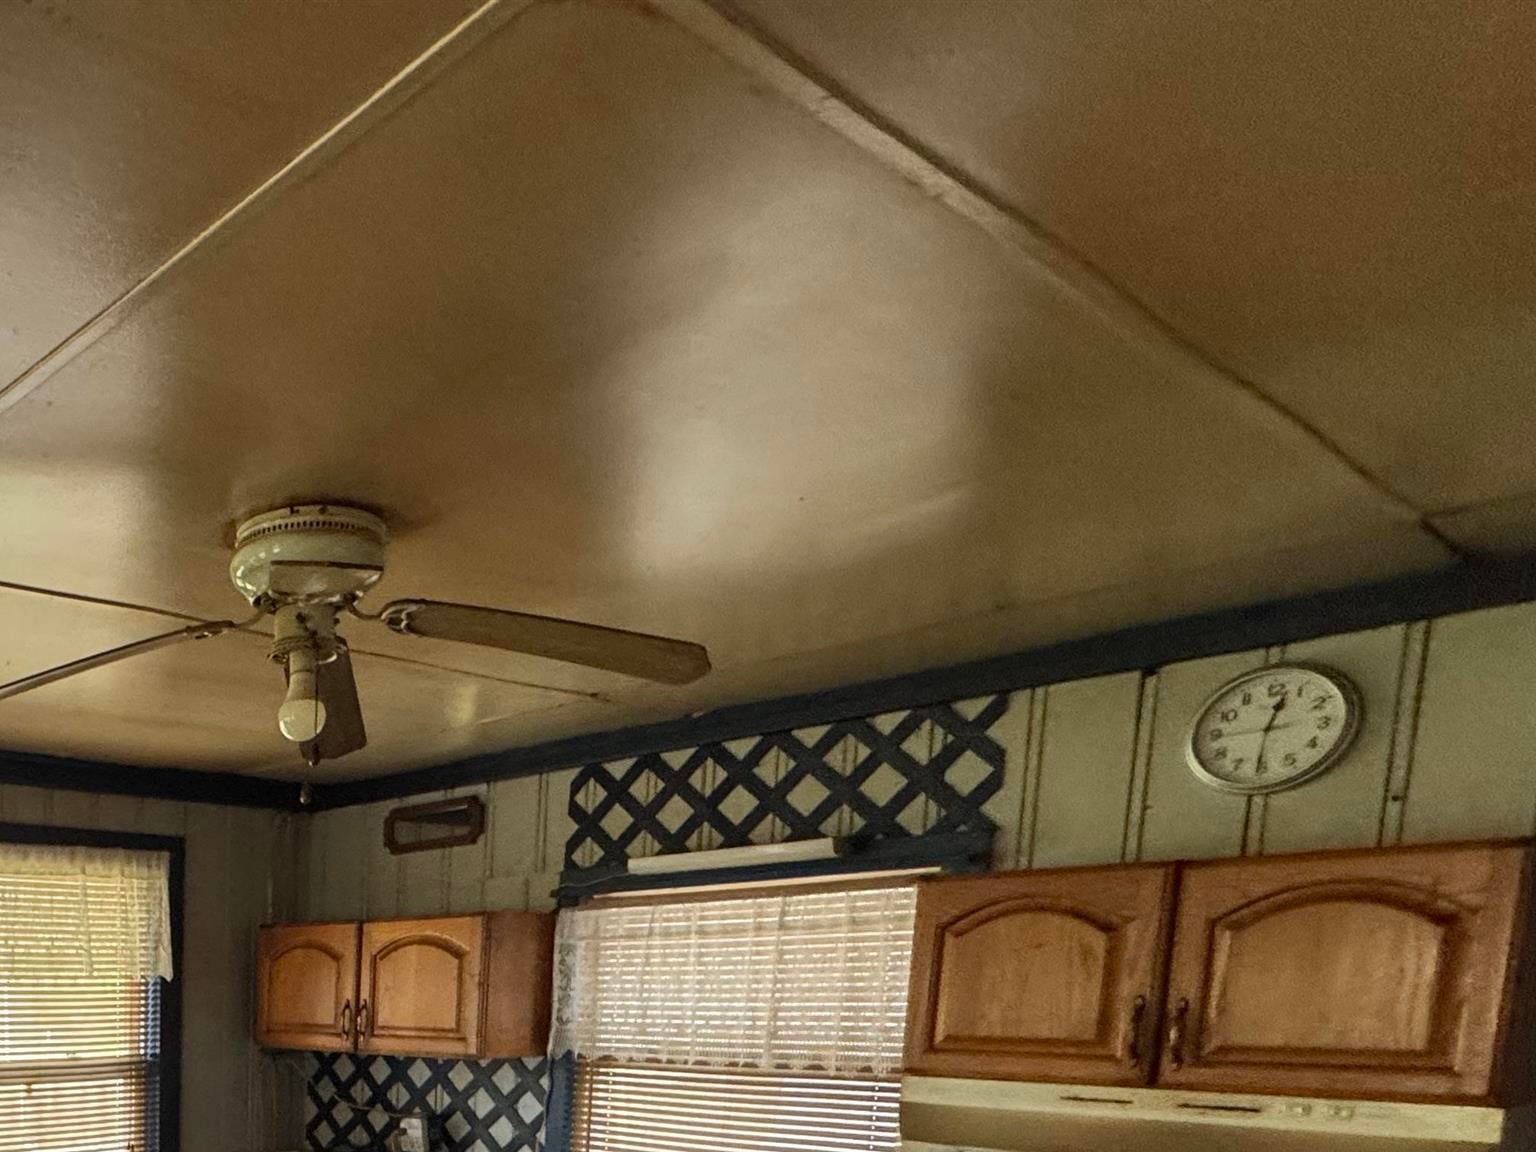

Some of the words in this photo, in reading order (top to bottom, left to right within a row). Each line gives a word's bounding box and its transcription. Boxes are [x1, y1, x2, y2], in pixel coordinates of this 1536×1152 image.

[1268, 683, 1286, 697] 12
[1311, 696, 1328, 710] 2
[1221, 709, 1238, 722] 10
[1317, 715, 1331, 730] 3
[1210, 728, 1223, 741] 9
[1306, 736, 1318, 749] 4
[1232, 758, 1244, 771] 7
[1282, 752, 1297, 767] 5
